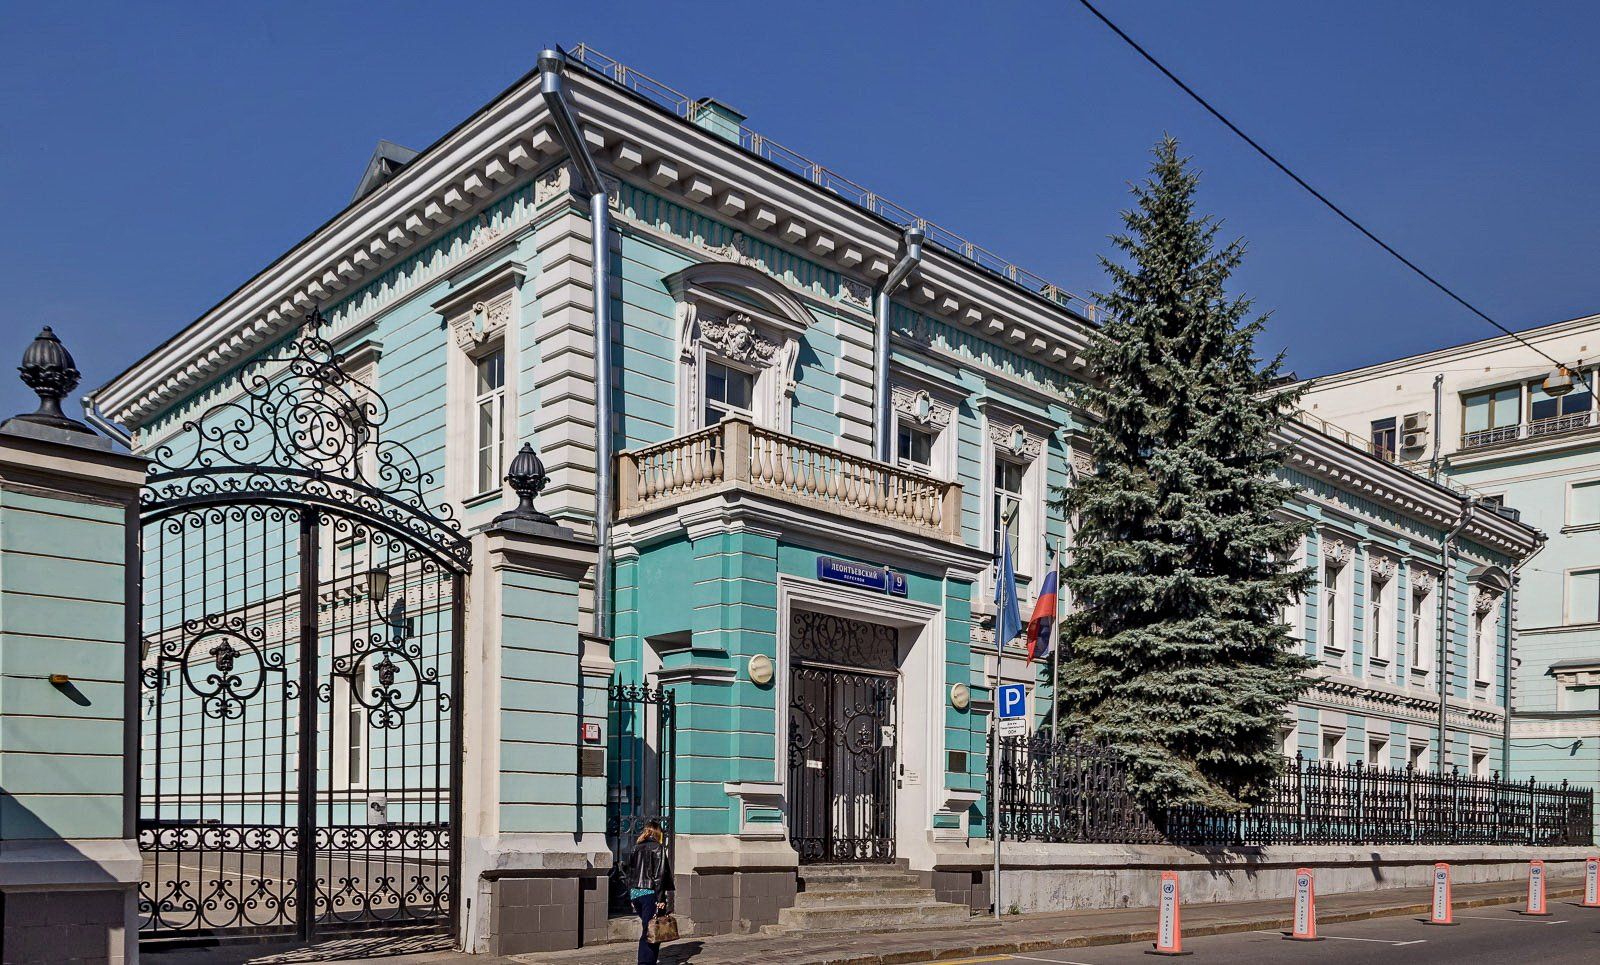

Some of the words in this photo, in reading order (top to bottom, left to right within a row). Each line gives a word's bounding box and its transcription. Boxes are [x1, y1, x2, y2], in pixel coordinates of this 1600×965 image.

[831, 563, 878, 579] ЛЕОНТЬЕВСКИЙ
[896, 576, 903, 587] 9
[1006, 688, 1020, 714] P
